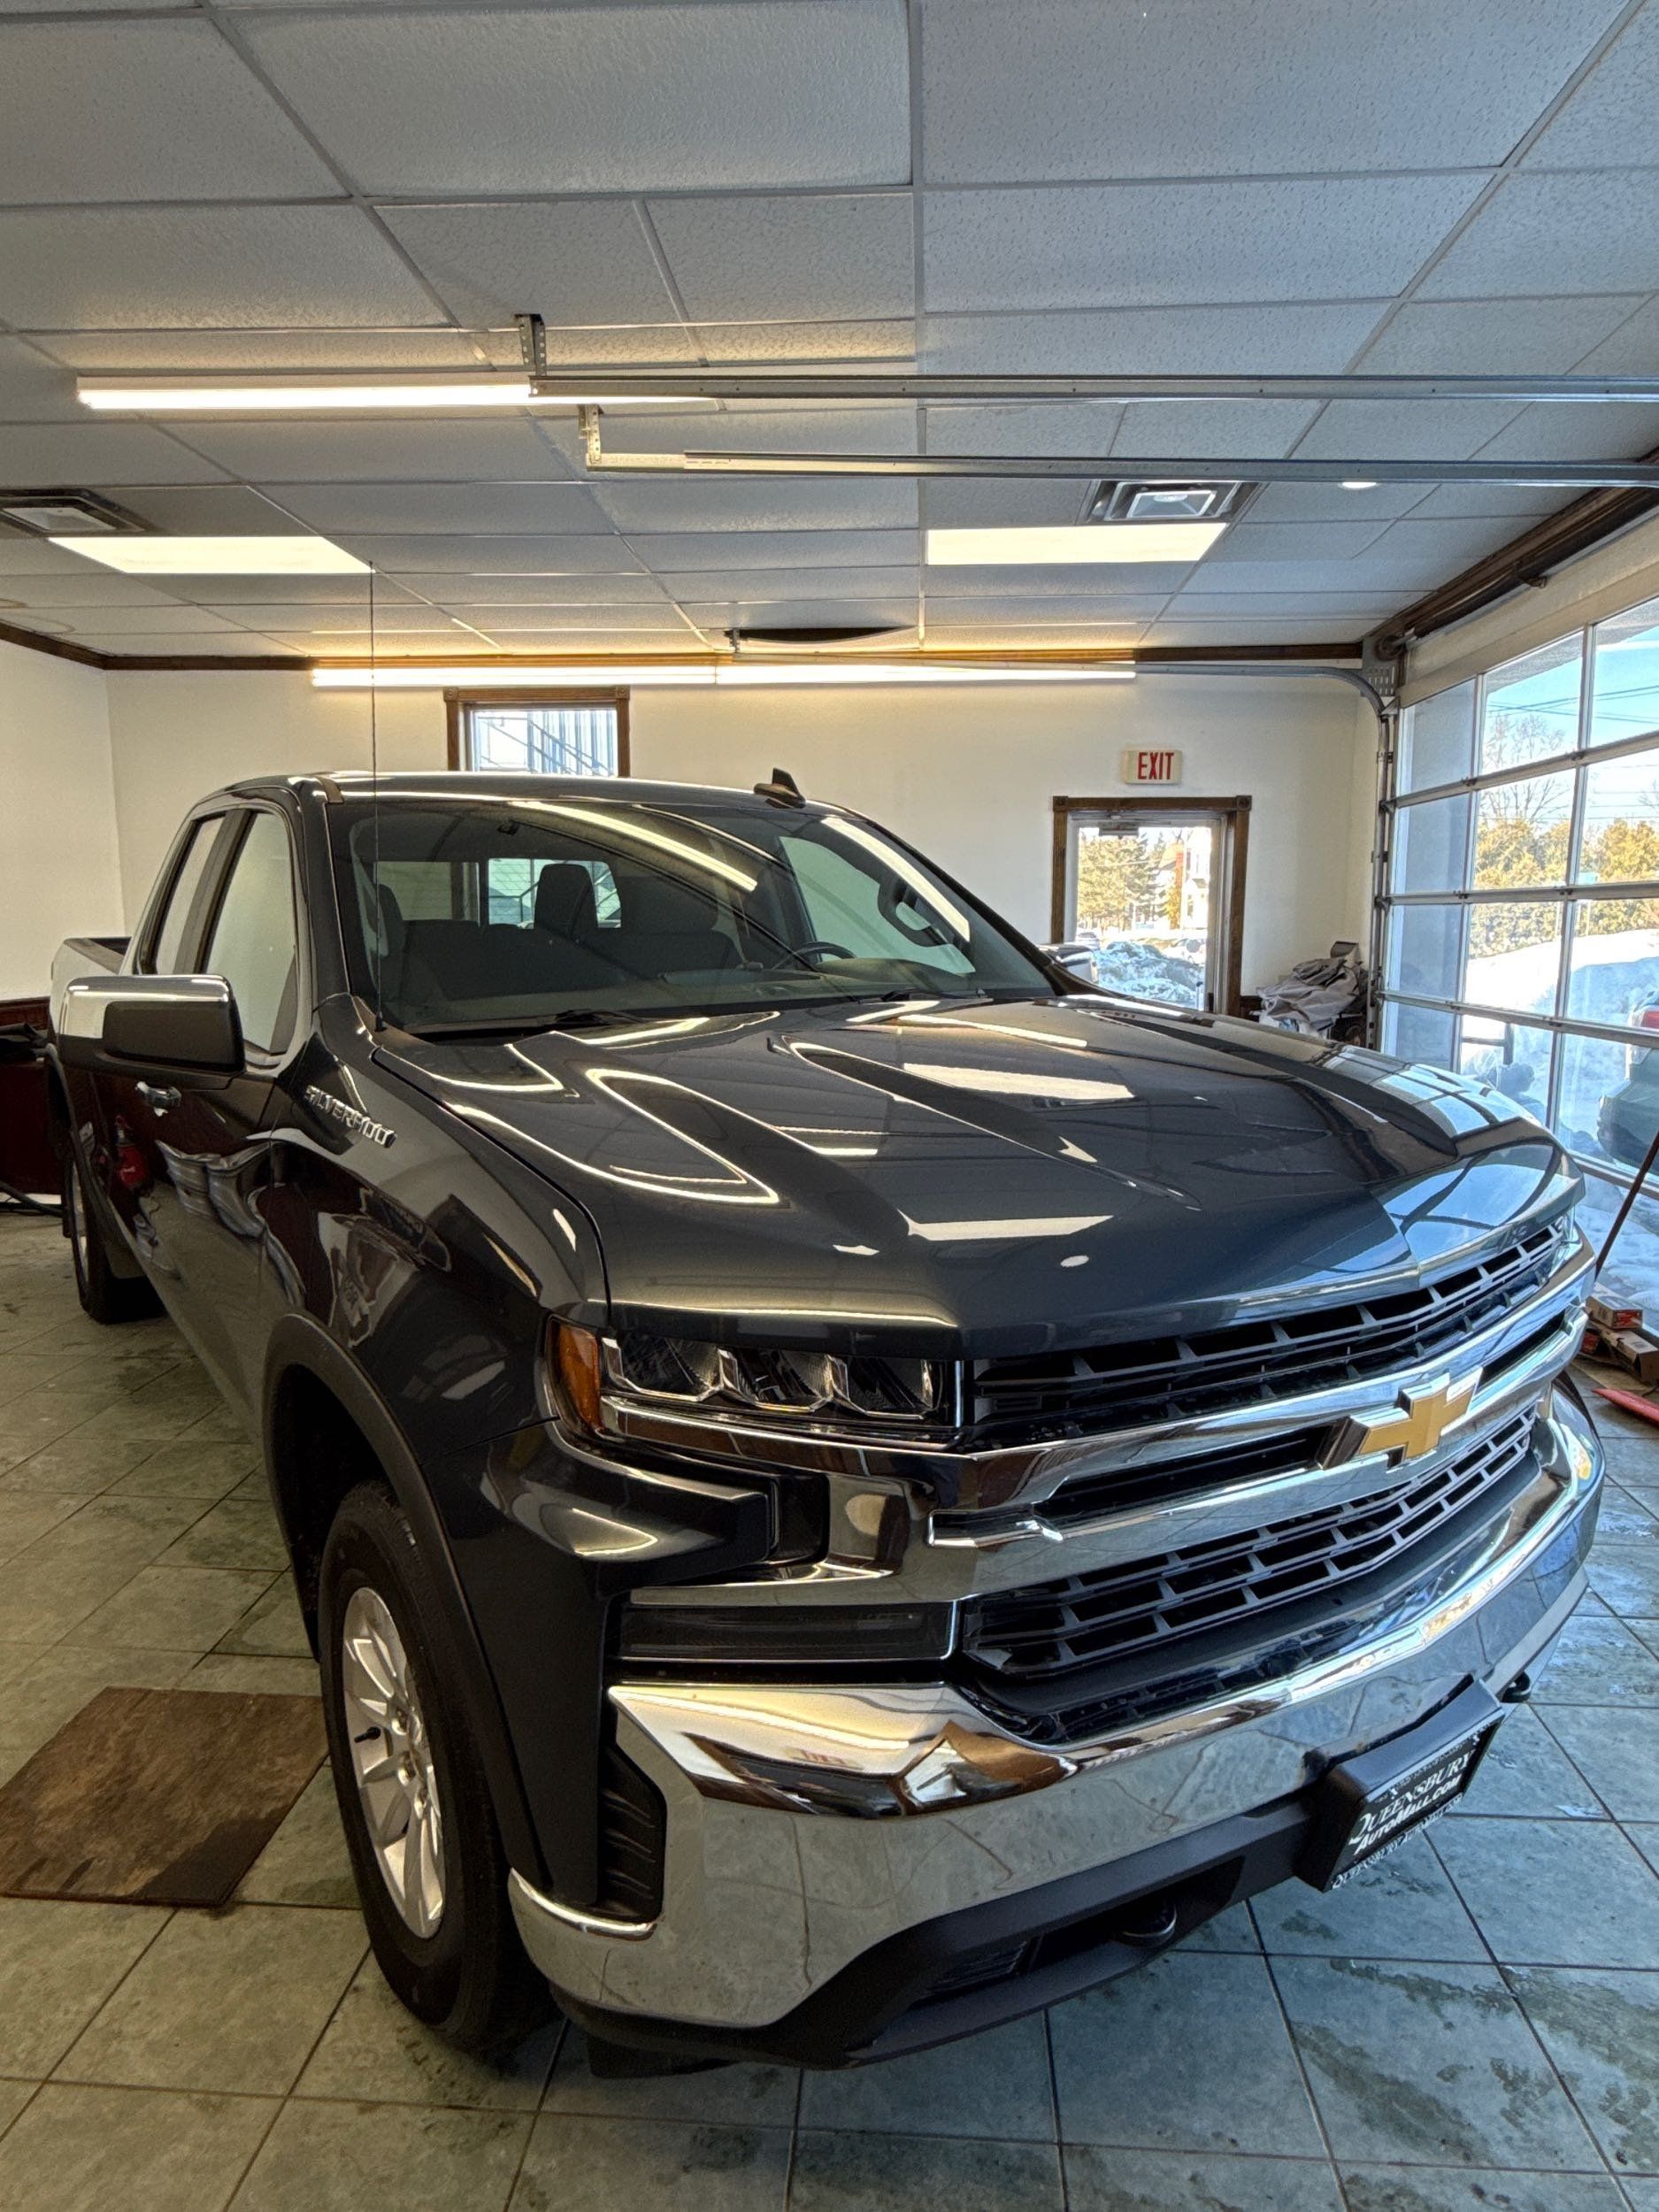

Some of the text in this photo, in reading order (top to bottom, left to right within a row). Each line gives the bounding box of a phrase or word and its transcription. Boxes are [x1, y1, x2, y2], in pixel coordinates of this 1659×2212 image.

[1138, 752, 1175, 780] EXIT
[304, 1085, 396, 1147] SILVERADO
[1348, 1749, 1476, 1845] QUEENSBURY
